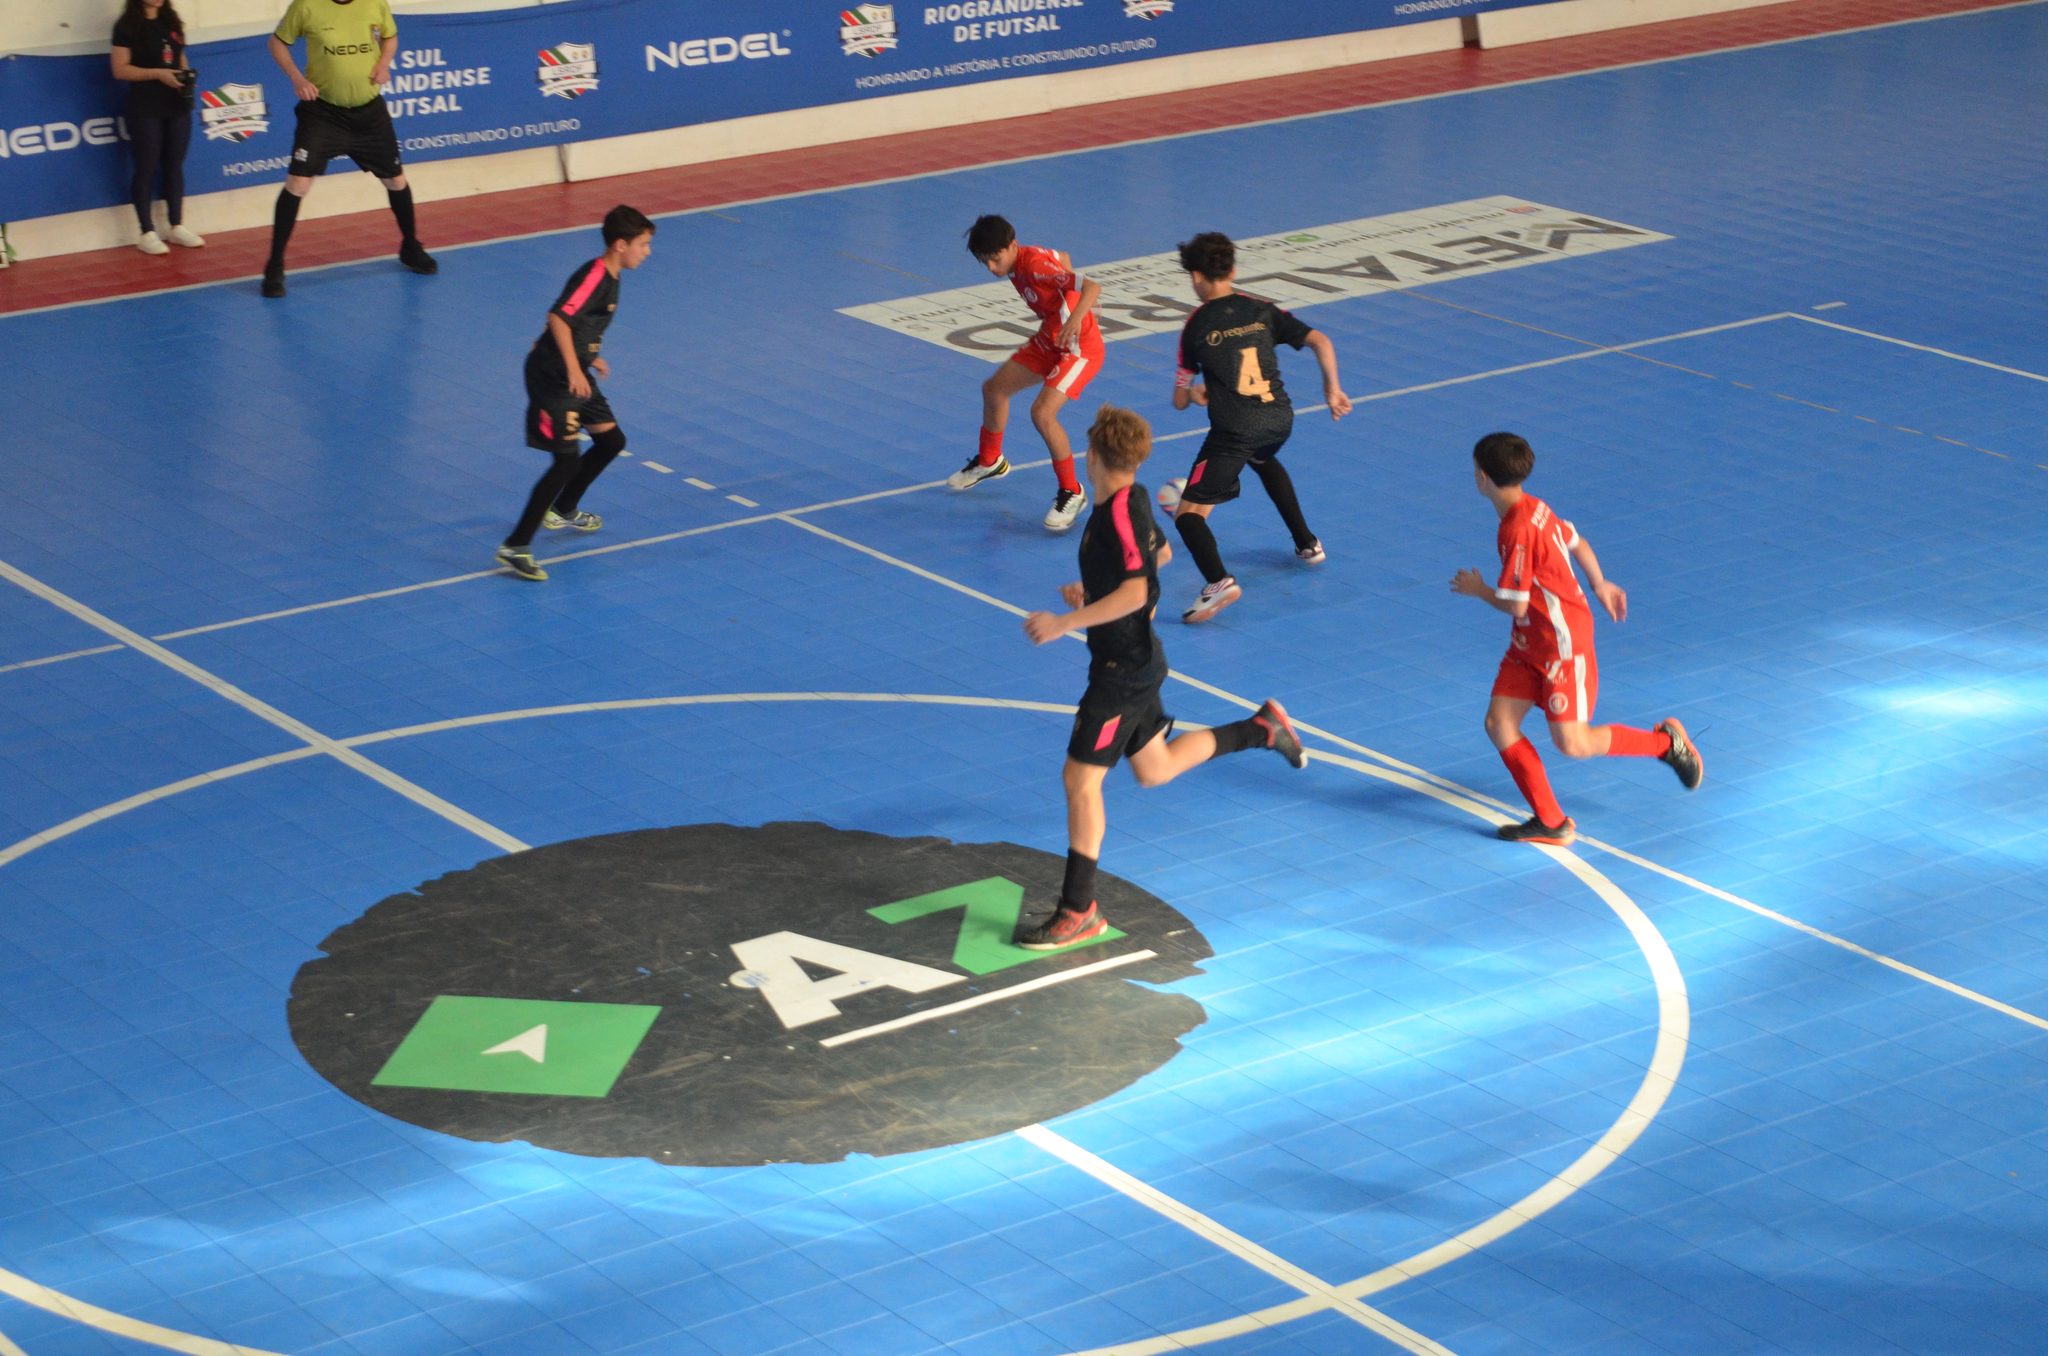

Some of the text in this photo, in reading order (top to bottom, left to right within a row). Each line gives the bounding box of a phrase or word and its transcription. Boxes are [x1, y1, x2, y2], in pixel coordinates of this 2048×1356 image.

[953, 14, 1061, 43] DE FUTSAL
[401, 48, 447, 69] SUL
[645, 31, 791, 72] NEDEL
[855, 68, 932, 89] HONRANDO
[932, 66, 944, 78] A
[1002, 56, 1011, 69] E
[1011, 46, 1098, 67] CONSTRUINDO
[1099, 44, 1110, 56] O
[1110, 37, 1158, 54] FUTURO
[387, 94, 463, 118] UTSAL
[404, 128, 509, 151] CONSTRUINDO
[509, 126, 524, 138] O
[525, 118, 581, 136] FUTURO
[1237, 346, 1275, 403] 4
